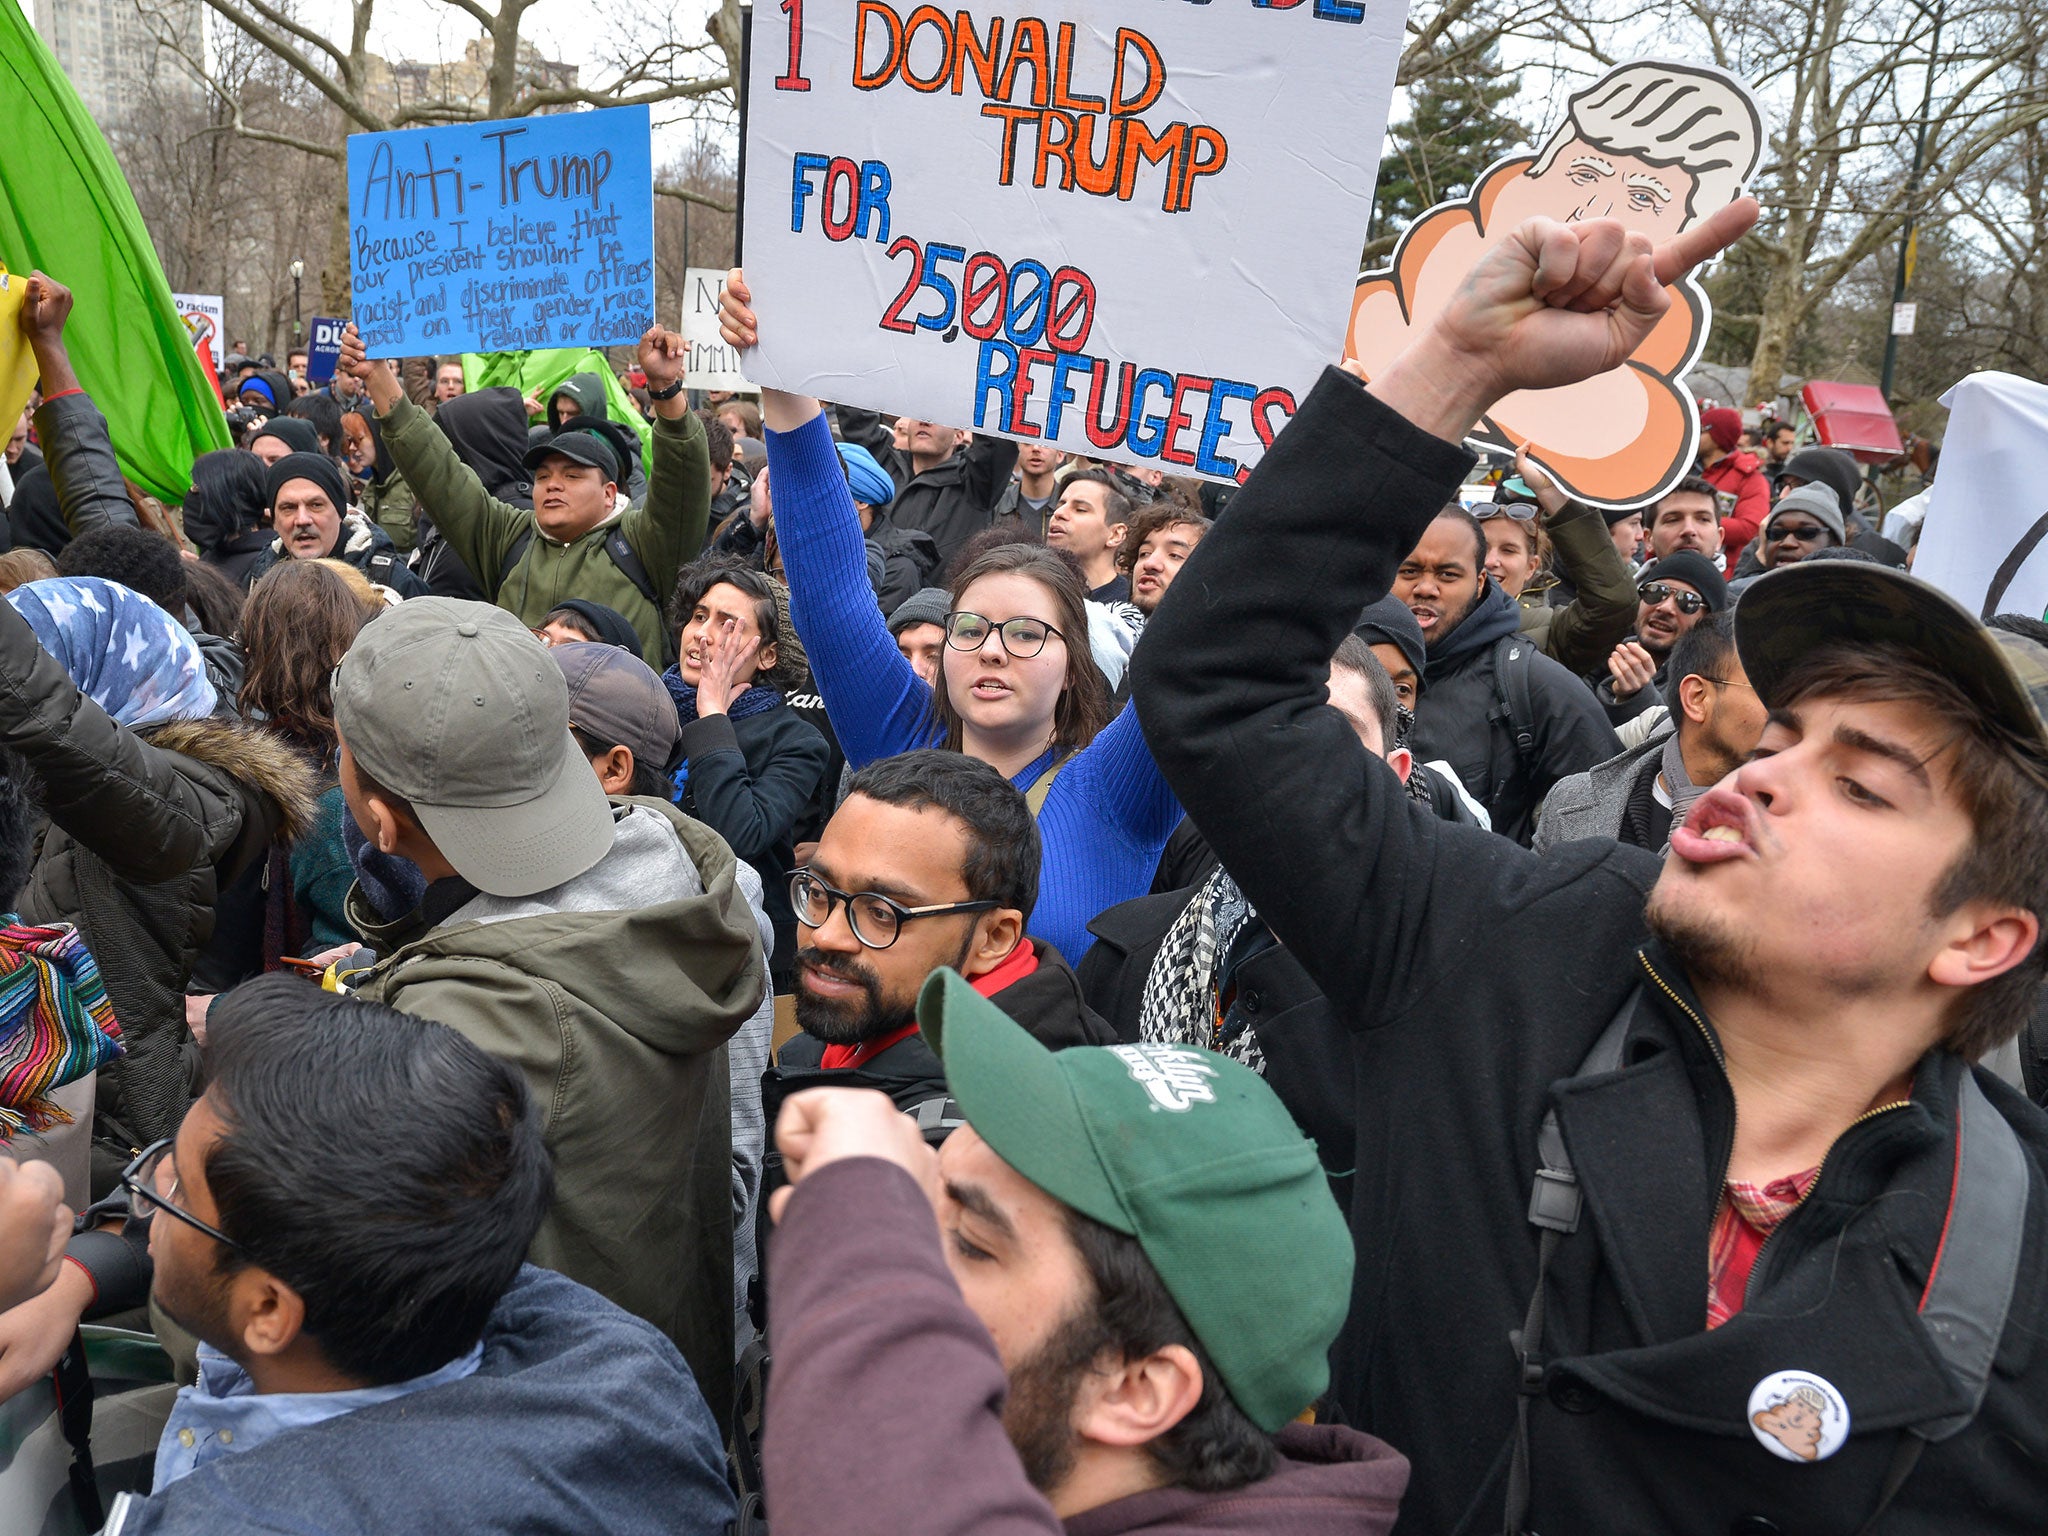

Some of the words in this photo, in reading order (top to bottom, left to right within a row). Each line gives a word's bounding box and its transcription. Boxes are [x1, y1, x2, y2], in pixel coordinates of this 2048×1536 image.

[853, 0, 1168, 117] DONALD
[361, 123, 613, 222] Anti-Trump
[980, 103, 1229, 214] TRUMP
[790, 151, 893, 244] FOR
[353, 268, 391, 294] our
[407, 243, 487, 300] president
[598, 236, 625, 265] be
[354, 224, 437, 272] Because
[448, 220, 470, 252] I
[487, 212, 557, 247] believe
[570, 201, 623, 241] that
[186, 302, 219, 314] racism
[353, 289, 412, 329] racist,
[414, 282, 447, 317] and
[460, 266, 571, 310] discriminate
[422, 316, 451, 339] on
[462, 302, 516, 333] their
[879, 235, 1097, 354] 25,000
[480, 318, 552, 350] religion
[559, 321, 582, 342] or
